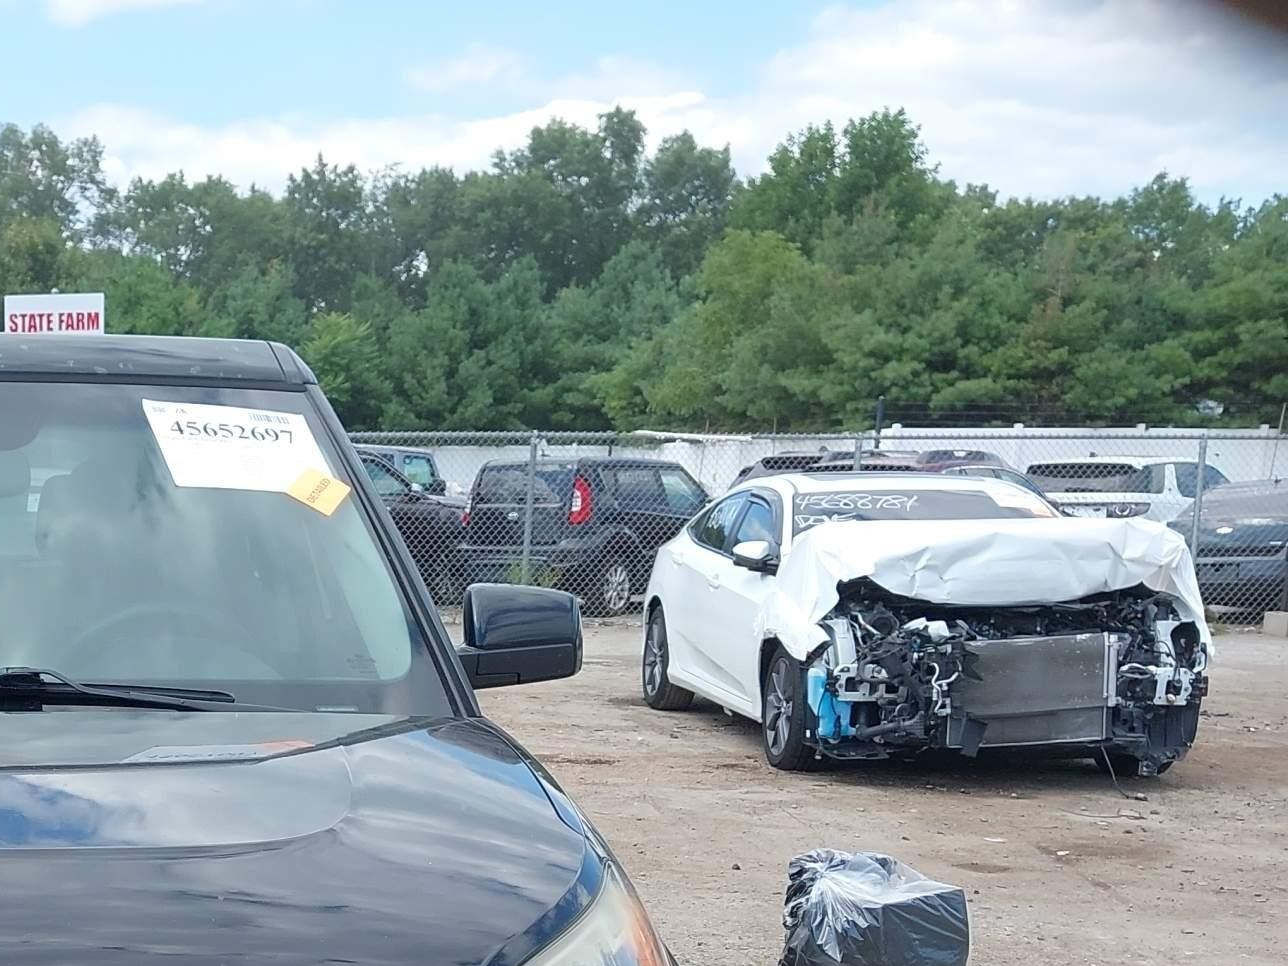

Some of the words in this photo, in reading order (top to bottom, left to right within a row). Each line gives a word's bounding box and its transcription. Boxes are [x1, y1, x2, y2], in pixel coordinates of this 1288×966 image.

[9, 312, 54, 333] STATE
[58, 311, 100, 331] FARM
[170, 420, 292, 444] 45652697
